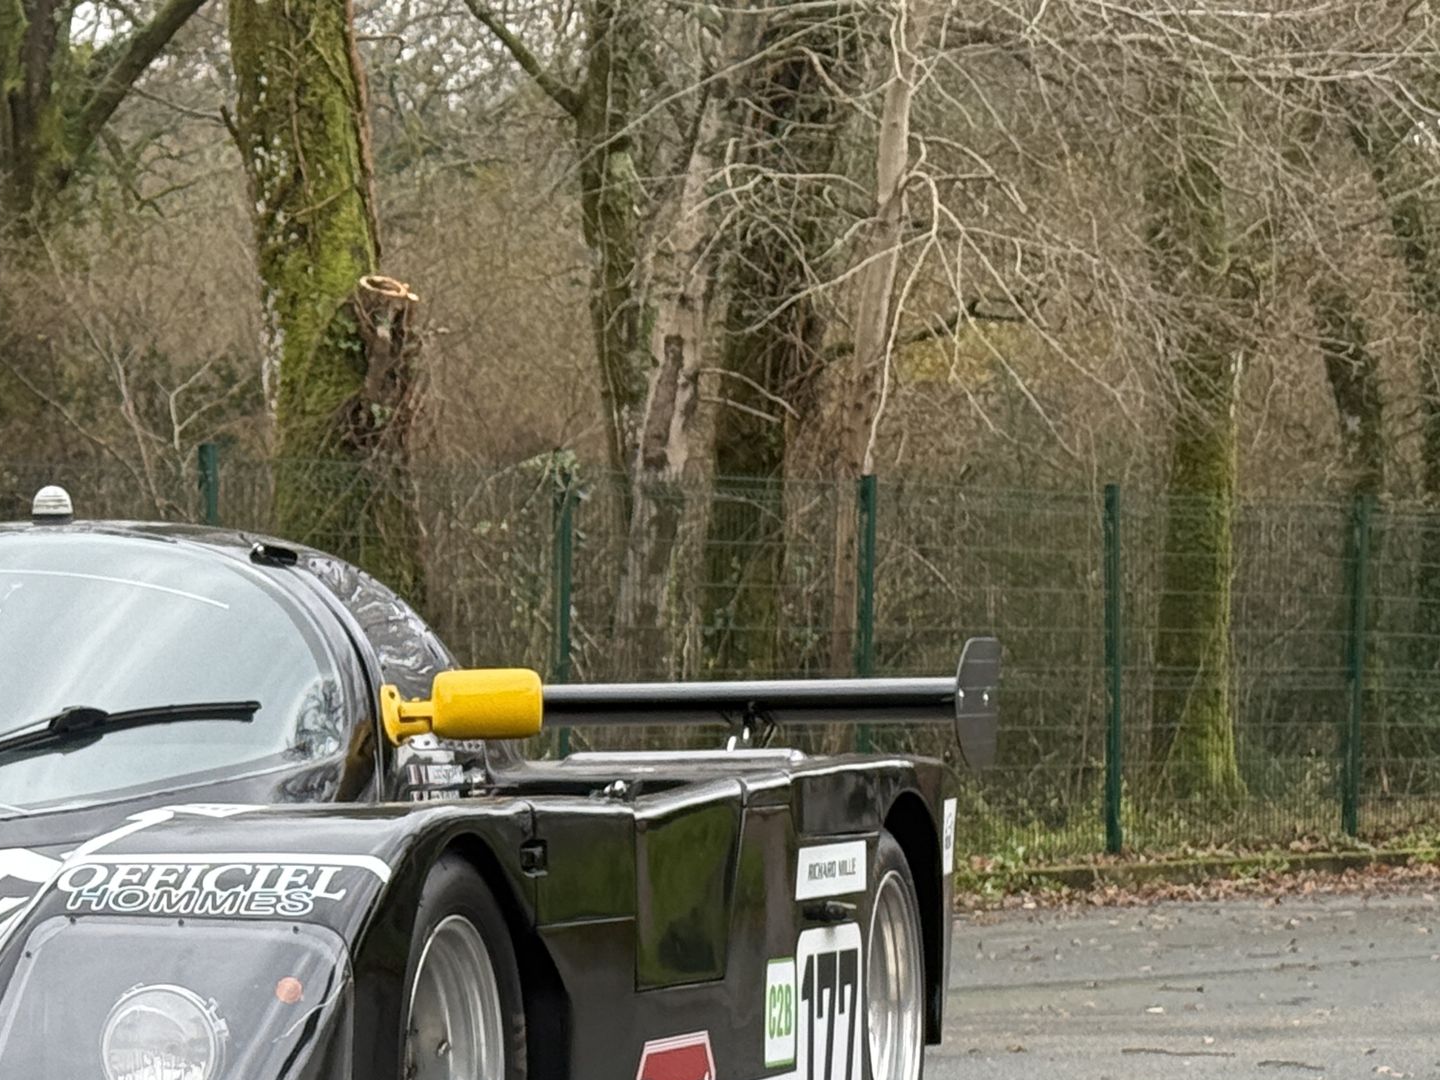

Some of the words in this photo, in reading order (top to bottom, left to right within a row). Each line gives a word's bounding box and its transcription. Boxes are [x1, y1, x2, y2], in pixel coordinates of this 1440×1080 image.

[57, 864, 348, 901] OFFICIEL
[66, 885, 315, 916] HOMMES
[768, 983, 793, 1040] C2B
